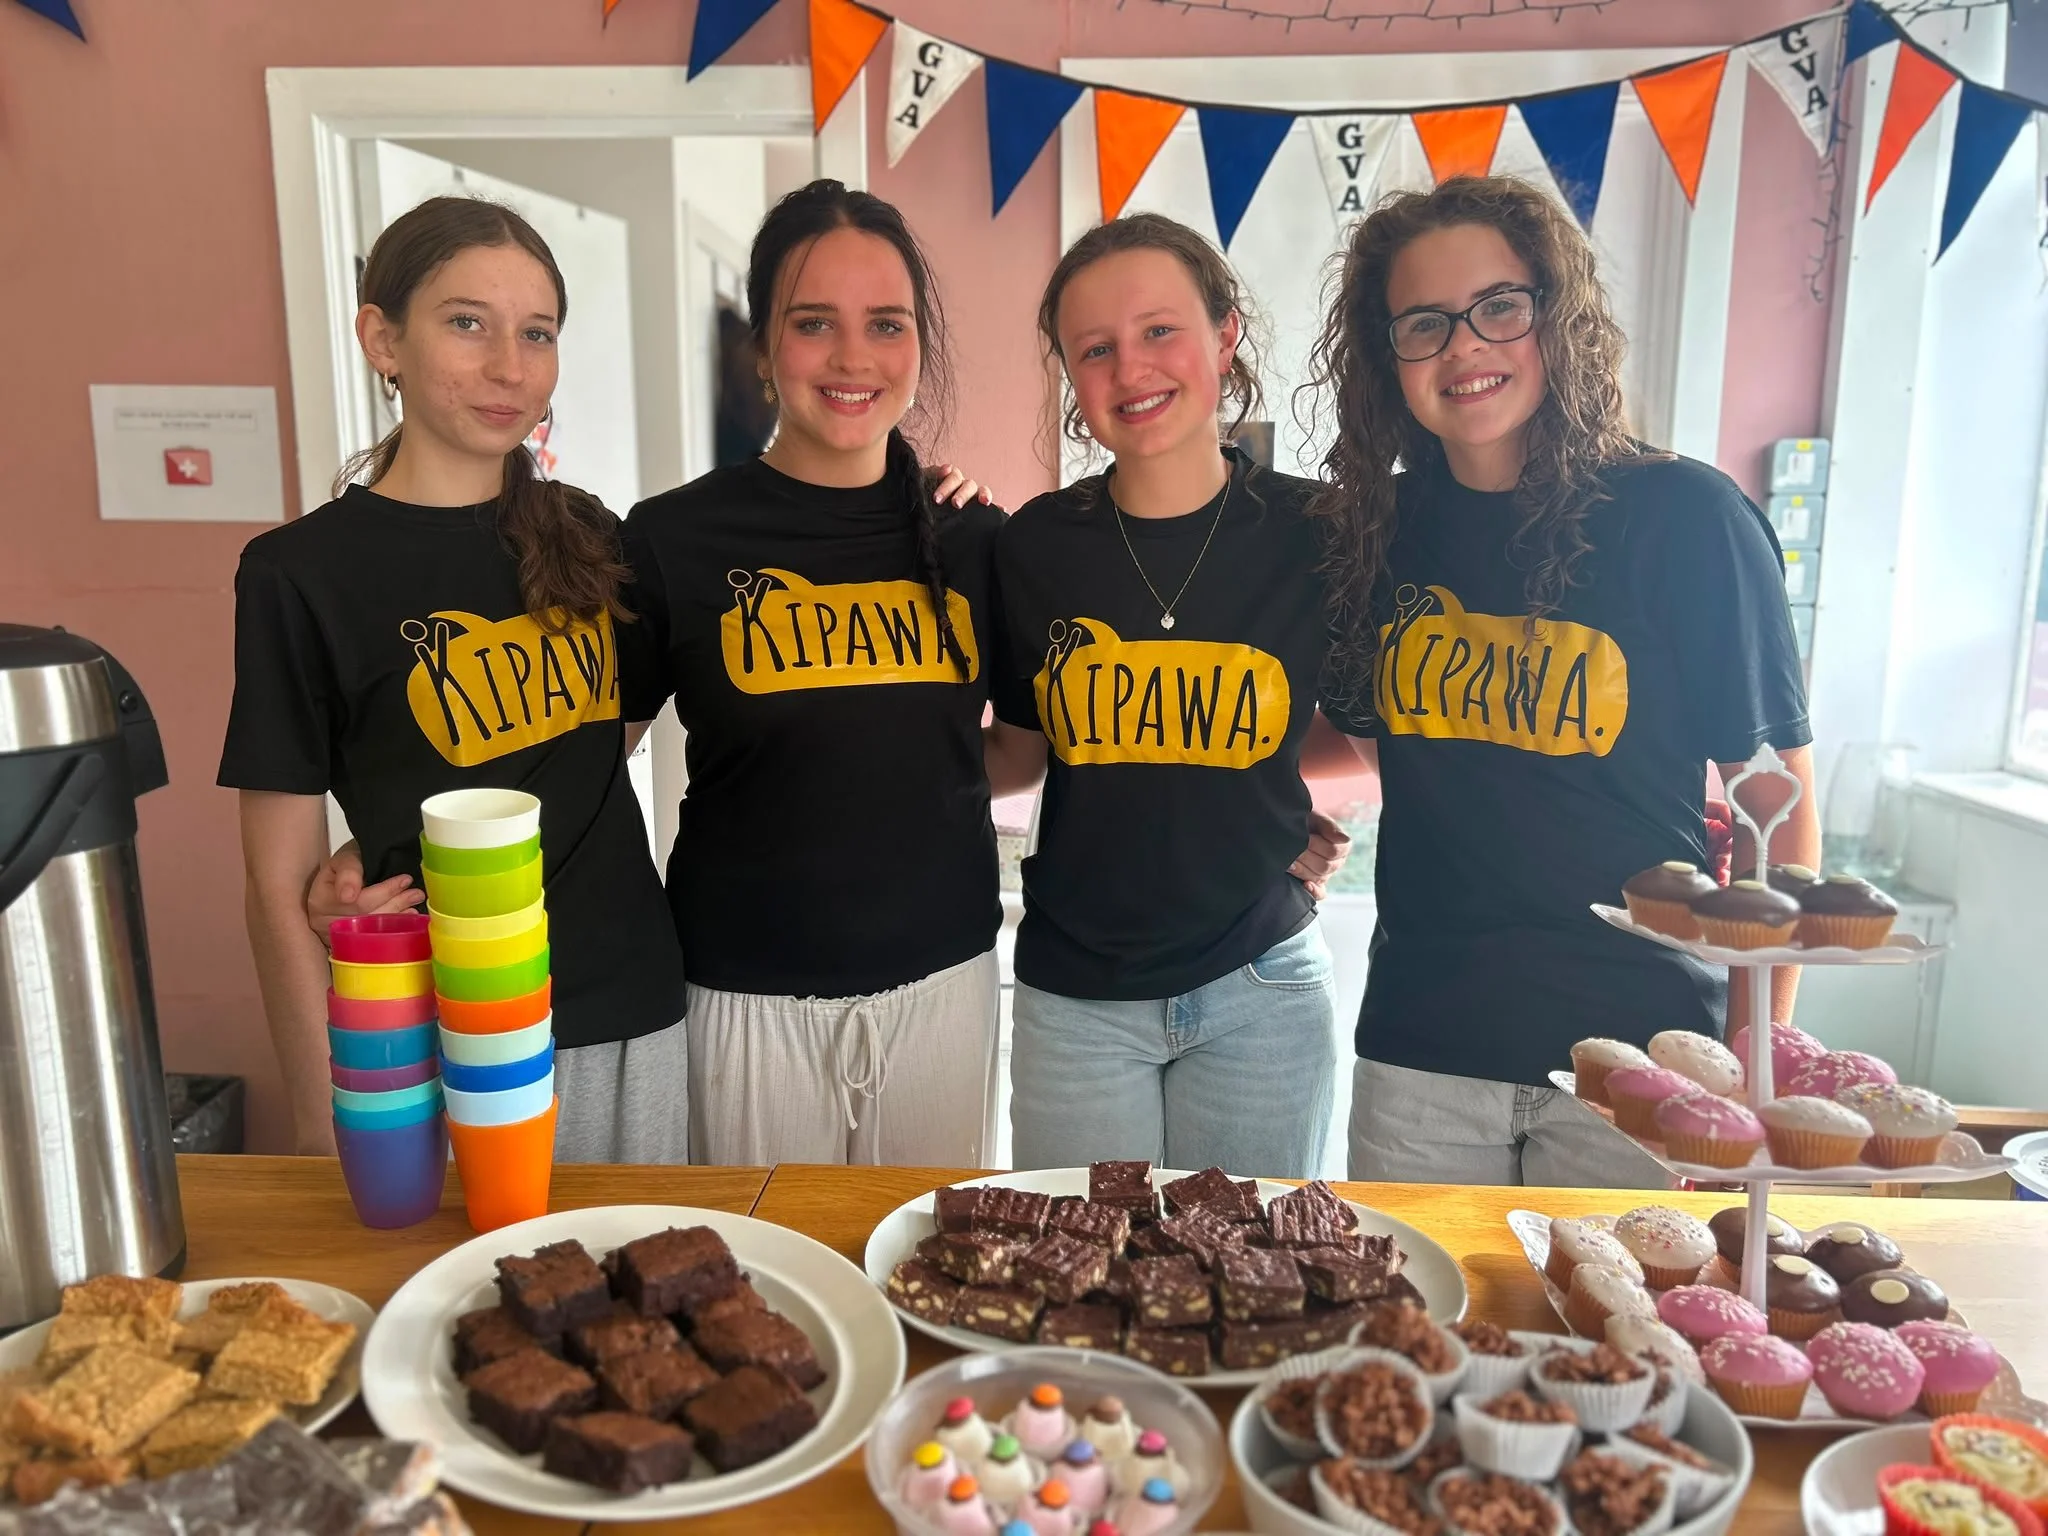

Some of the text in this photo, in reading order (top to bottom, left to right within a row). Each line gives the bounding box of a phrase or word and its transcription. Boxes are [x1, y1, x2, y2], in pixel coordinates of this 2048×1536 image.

[897, 40, 944, 129] GVA
[1780, 27, 1829, 115] GVA
[1335, 123, 1368, 212] GVA
